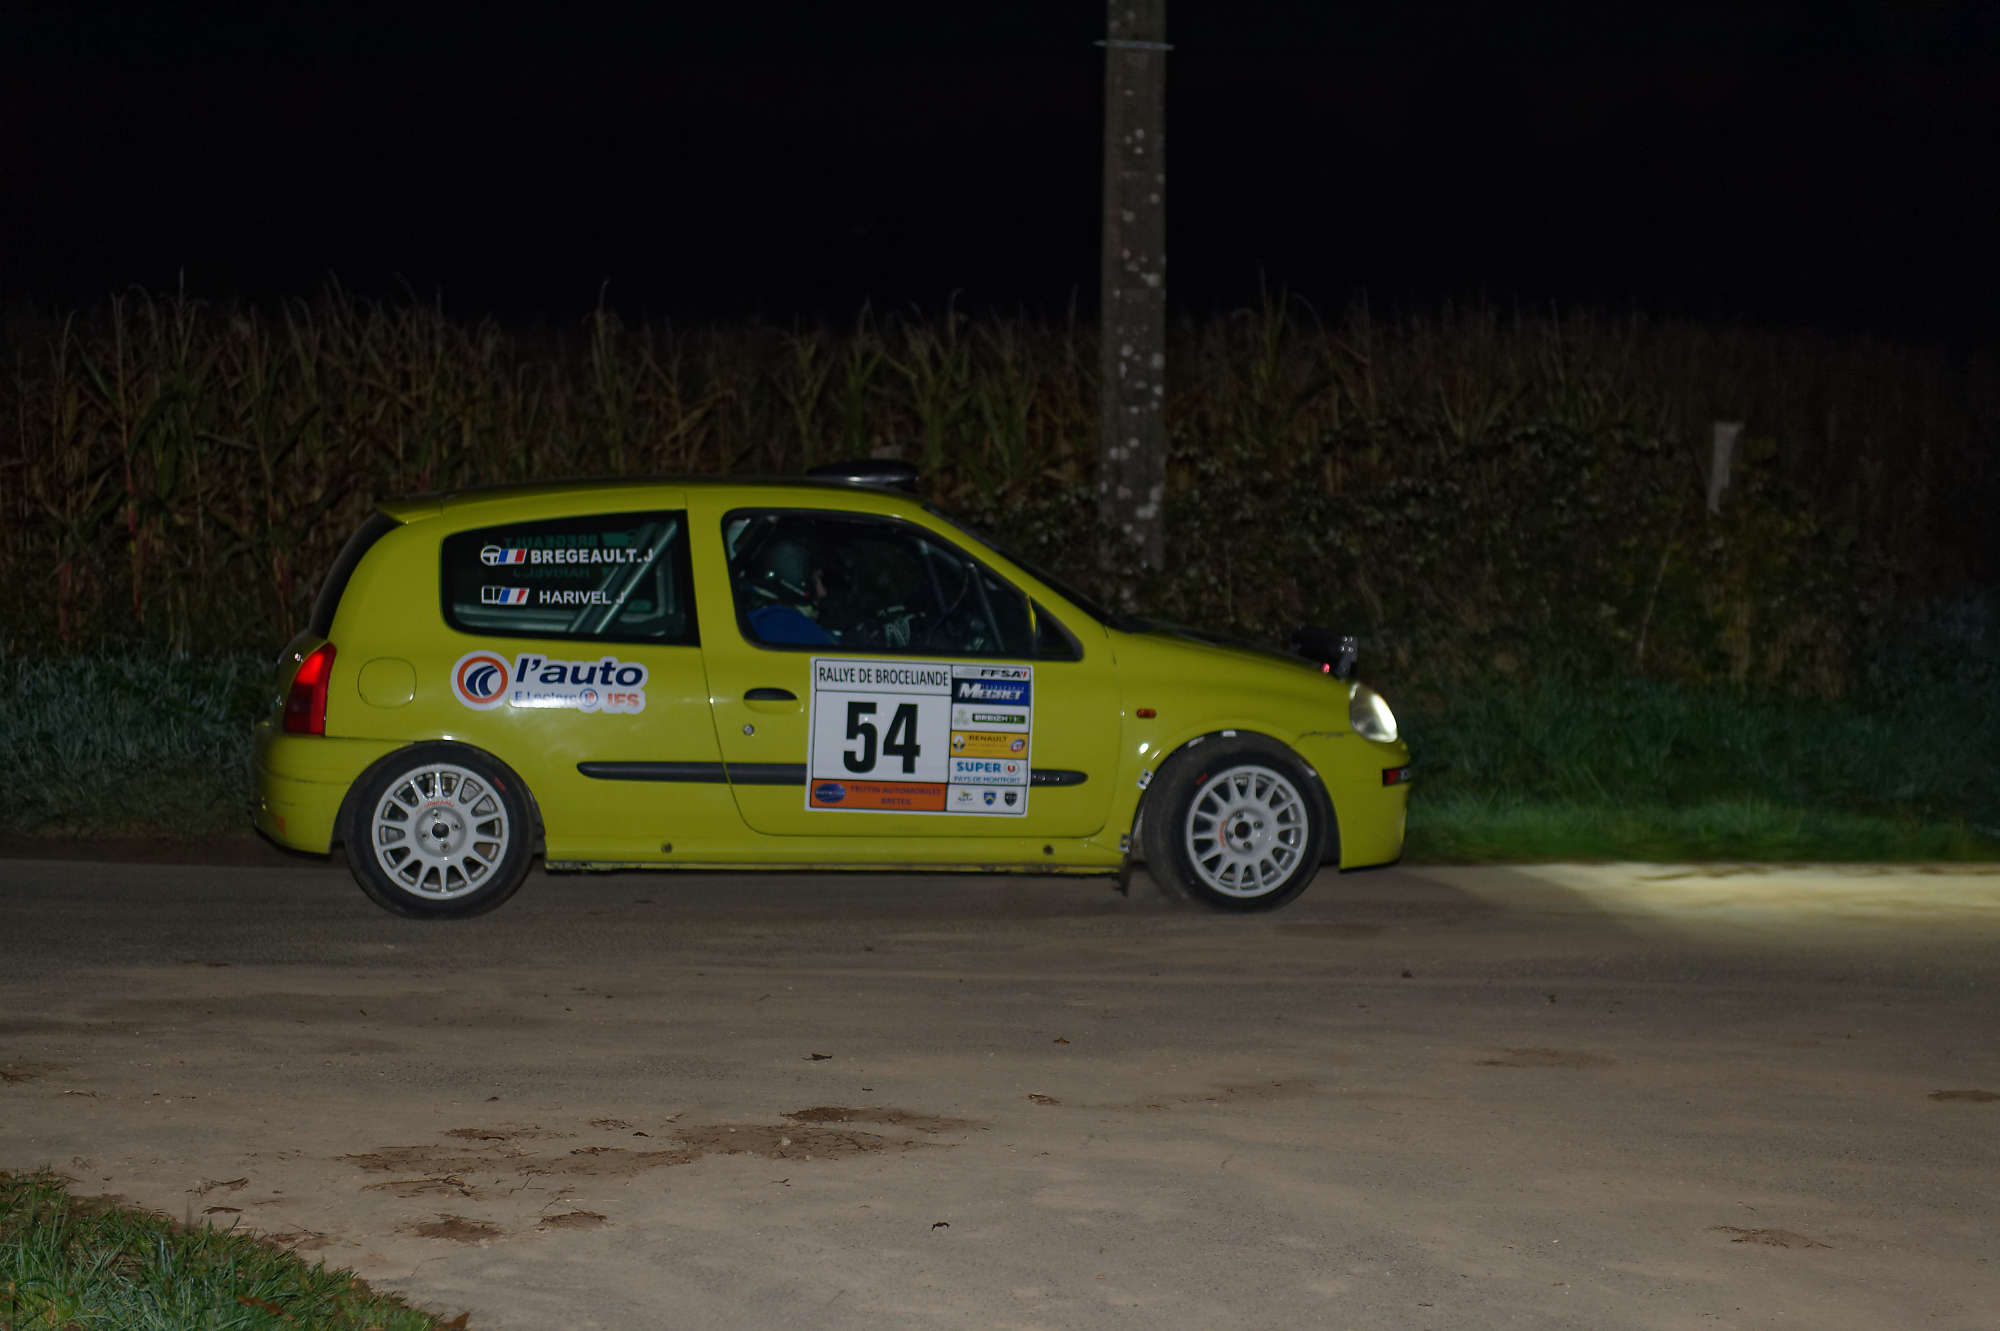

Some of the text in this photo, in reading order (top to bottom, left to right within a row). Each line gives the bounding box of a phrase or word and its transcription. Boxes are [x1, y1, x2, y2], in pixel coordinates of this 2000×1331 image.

[538, 590, 625, 605] HARIVEL J
[515, 658, 643, 686] l'auto
[819, 667, 949, 687] RALLYE DE BROCELIANDE
[981, 669, 1023, 678] FFSA
[843, 701, 921, 774] 54
[968, 735, 1008, 743] RENAULT
[956, 762, 1001, 773] SUPER
